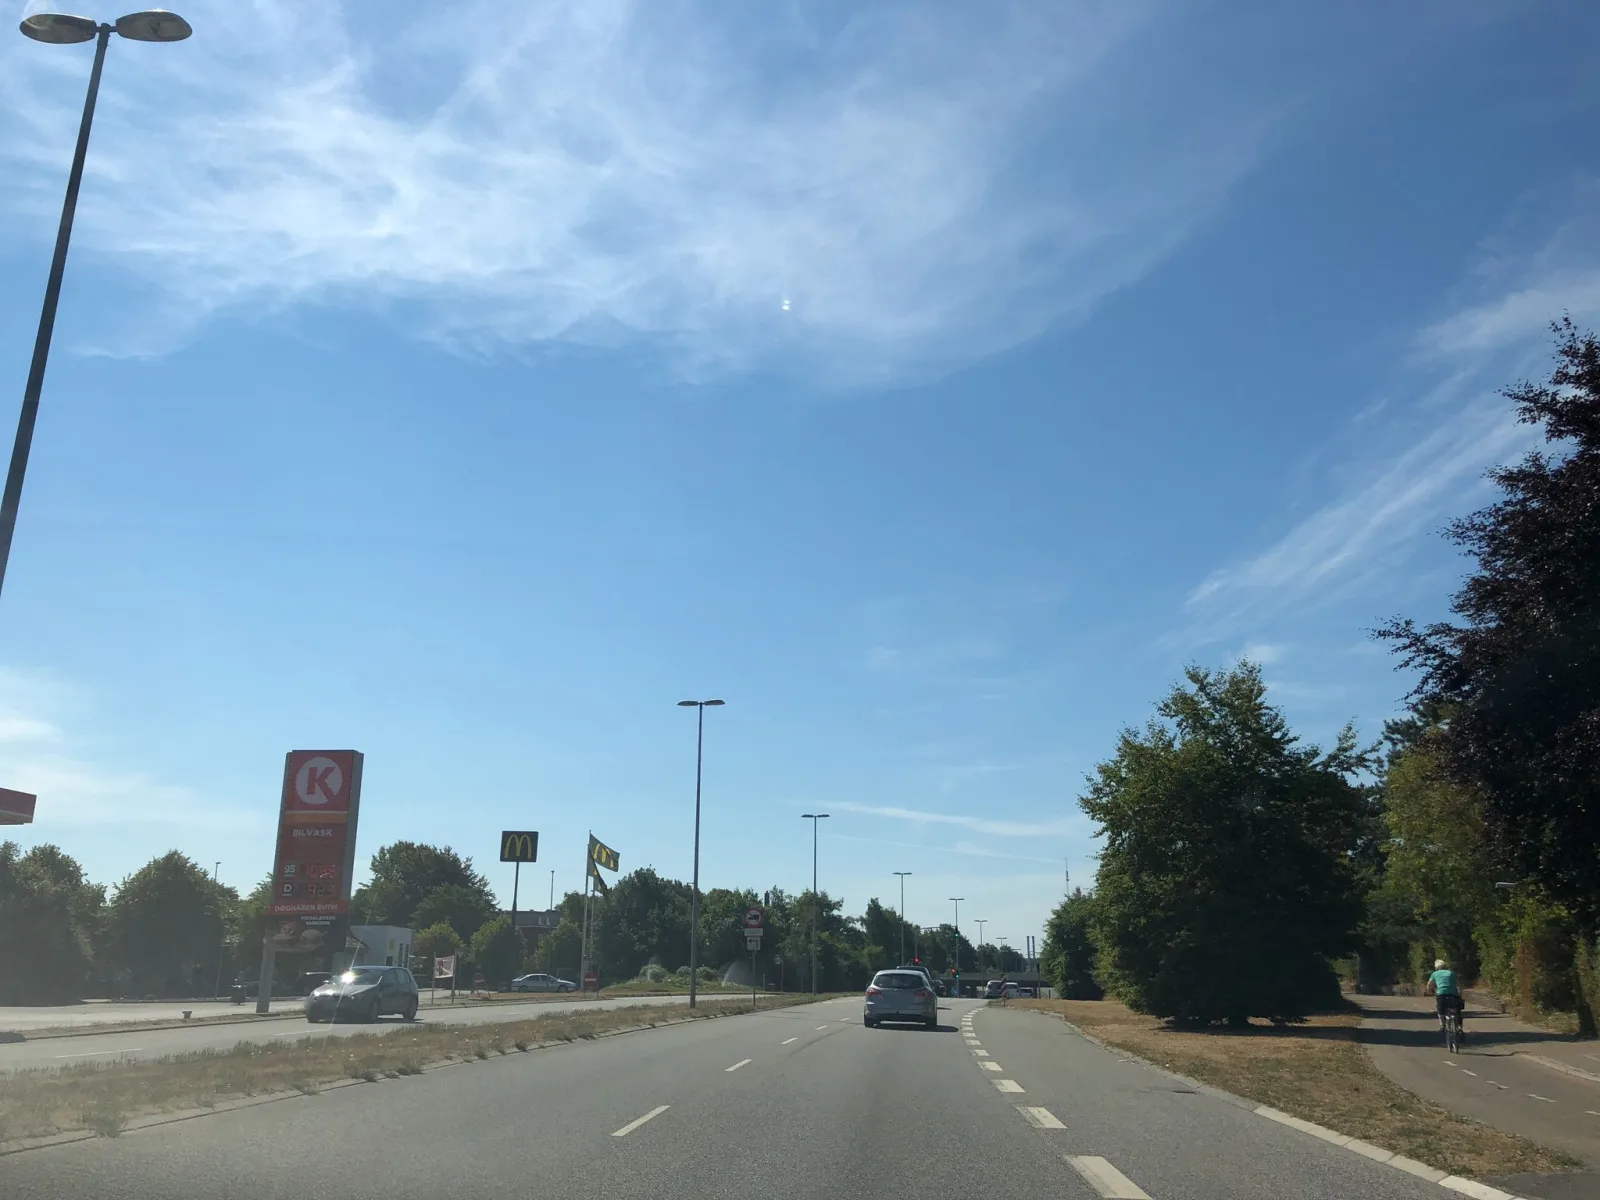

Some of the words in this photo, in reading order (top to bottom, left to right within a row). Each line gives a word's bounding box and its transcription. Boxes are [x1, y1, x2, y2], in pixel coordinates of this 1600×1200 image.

[306, 767, 337, 802] K
[292, 828, 333, 837] BILVASK
[284, 864, 296, 873] 95
[283, 883, 292, 892] D
